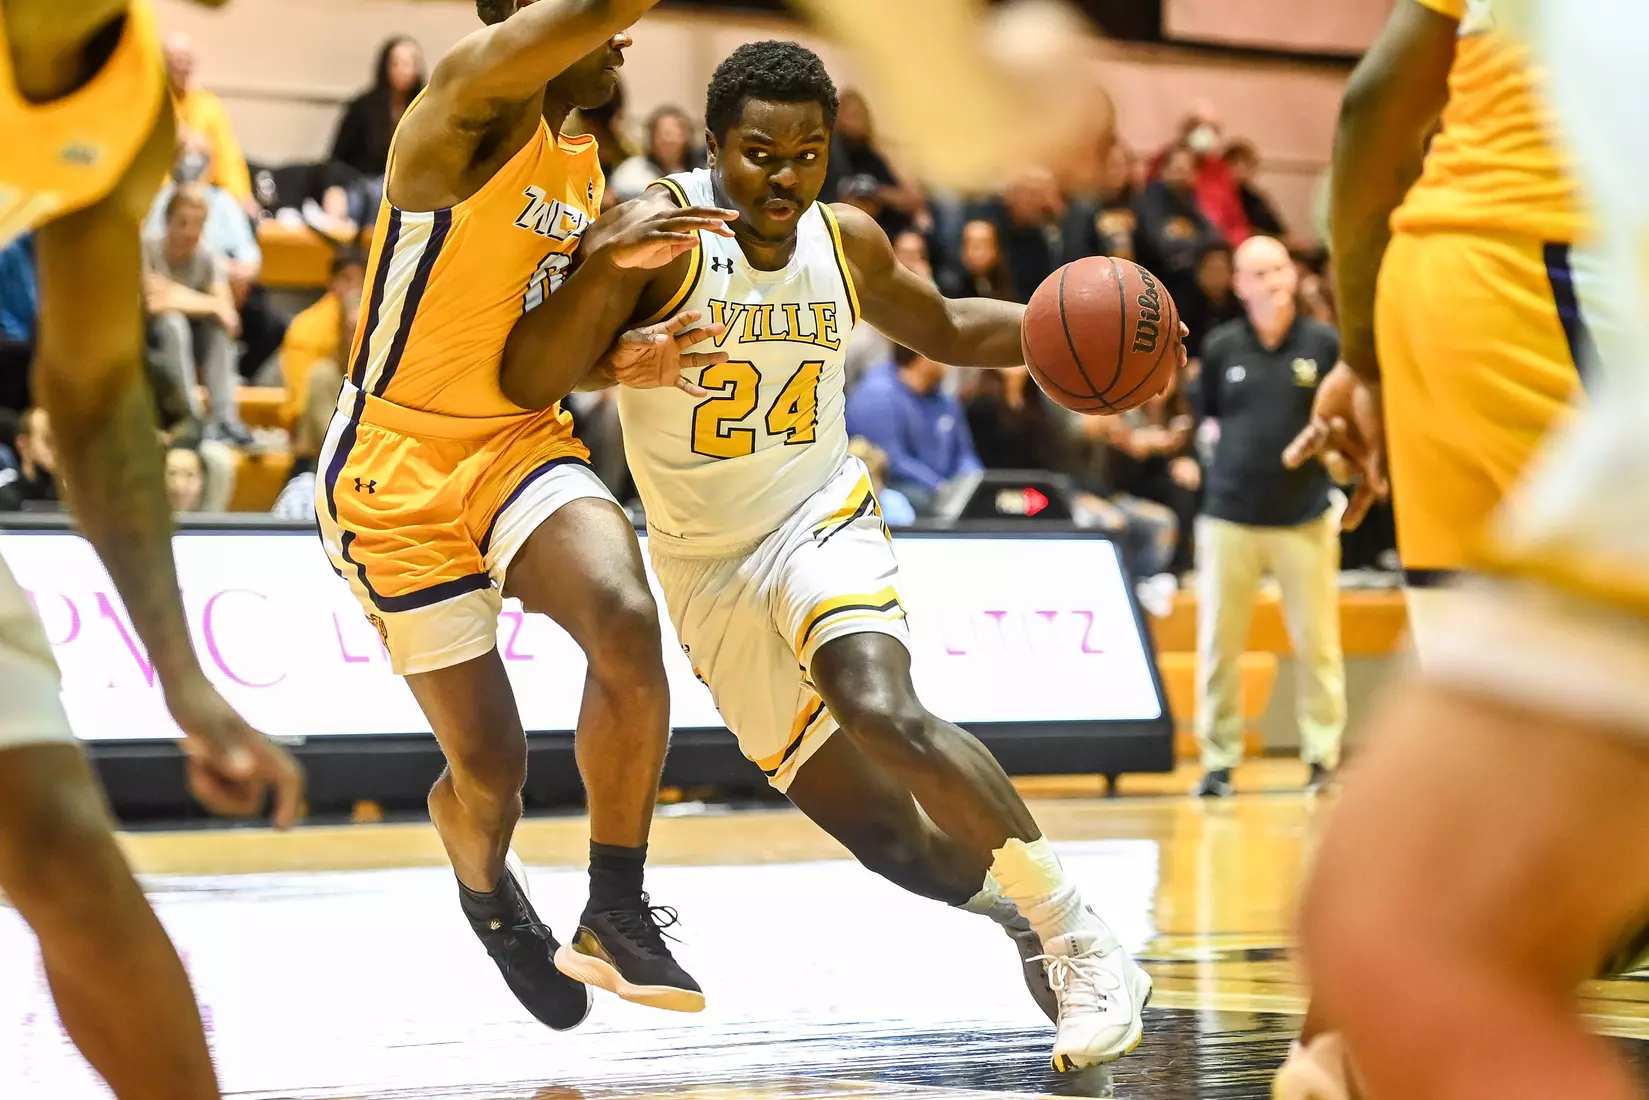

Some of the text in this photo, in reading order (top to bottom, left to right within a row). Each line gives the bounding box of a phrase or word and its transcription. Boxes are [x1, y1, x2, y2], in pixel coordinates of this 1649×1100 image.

[708, 298, 841, 352] VILLE
[1131, 264, 1161, 354] Wilson
[691, 360, 825, 460] 24
